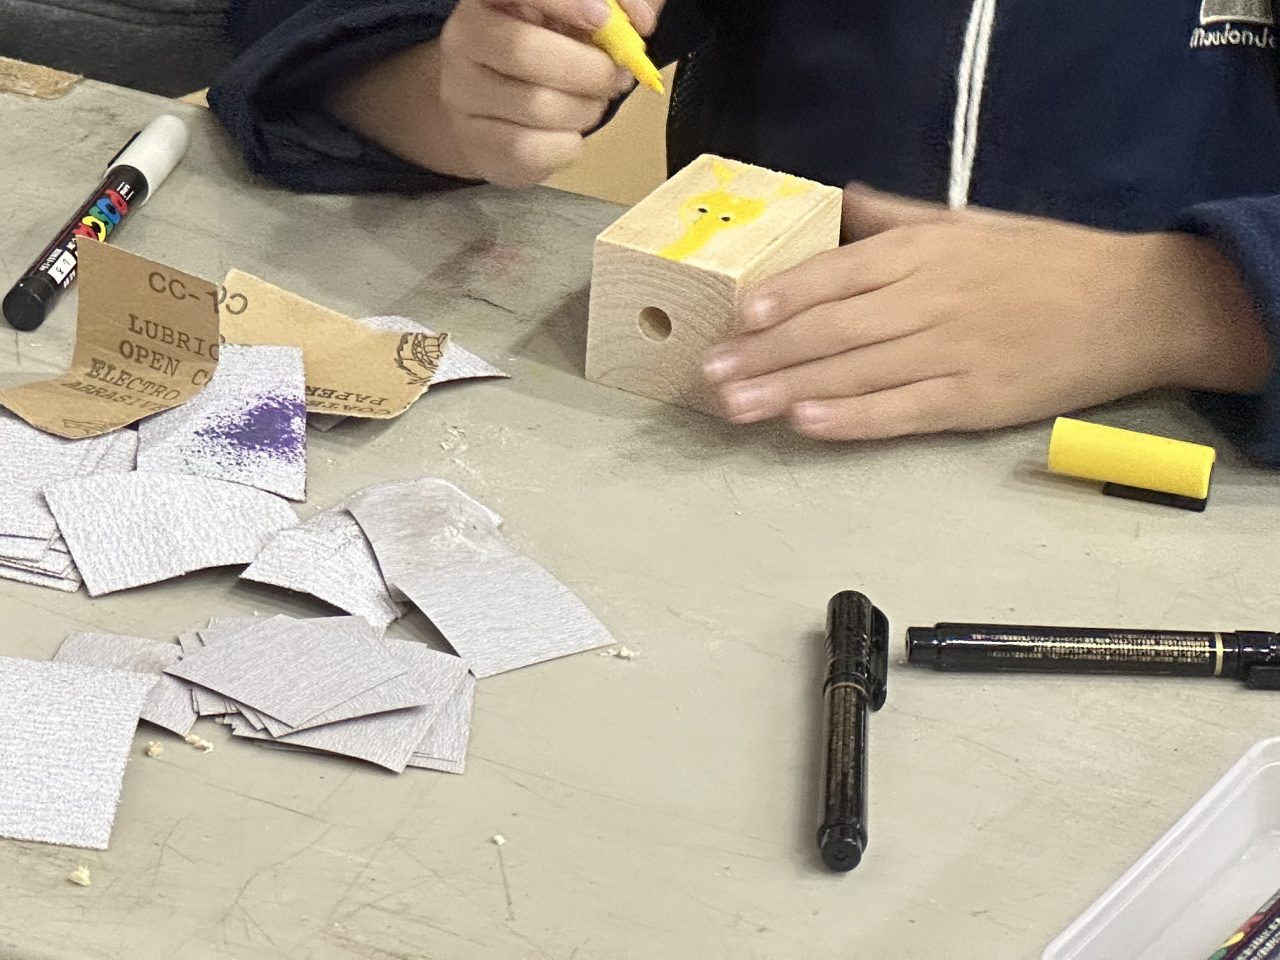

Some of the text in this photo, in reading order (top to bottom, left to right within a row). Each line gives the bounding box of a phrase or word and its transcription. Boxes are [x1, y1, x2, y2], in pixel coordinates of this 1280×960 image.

[72, 189, 128, 242] POSCA
[85, 357, 181, 402] ELECTRO
[119, 341, 213, 387] OPEN C
[304, 398, 390, 417] COATE
